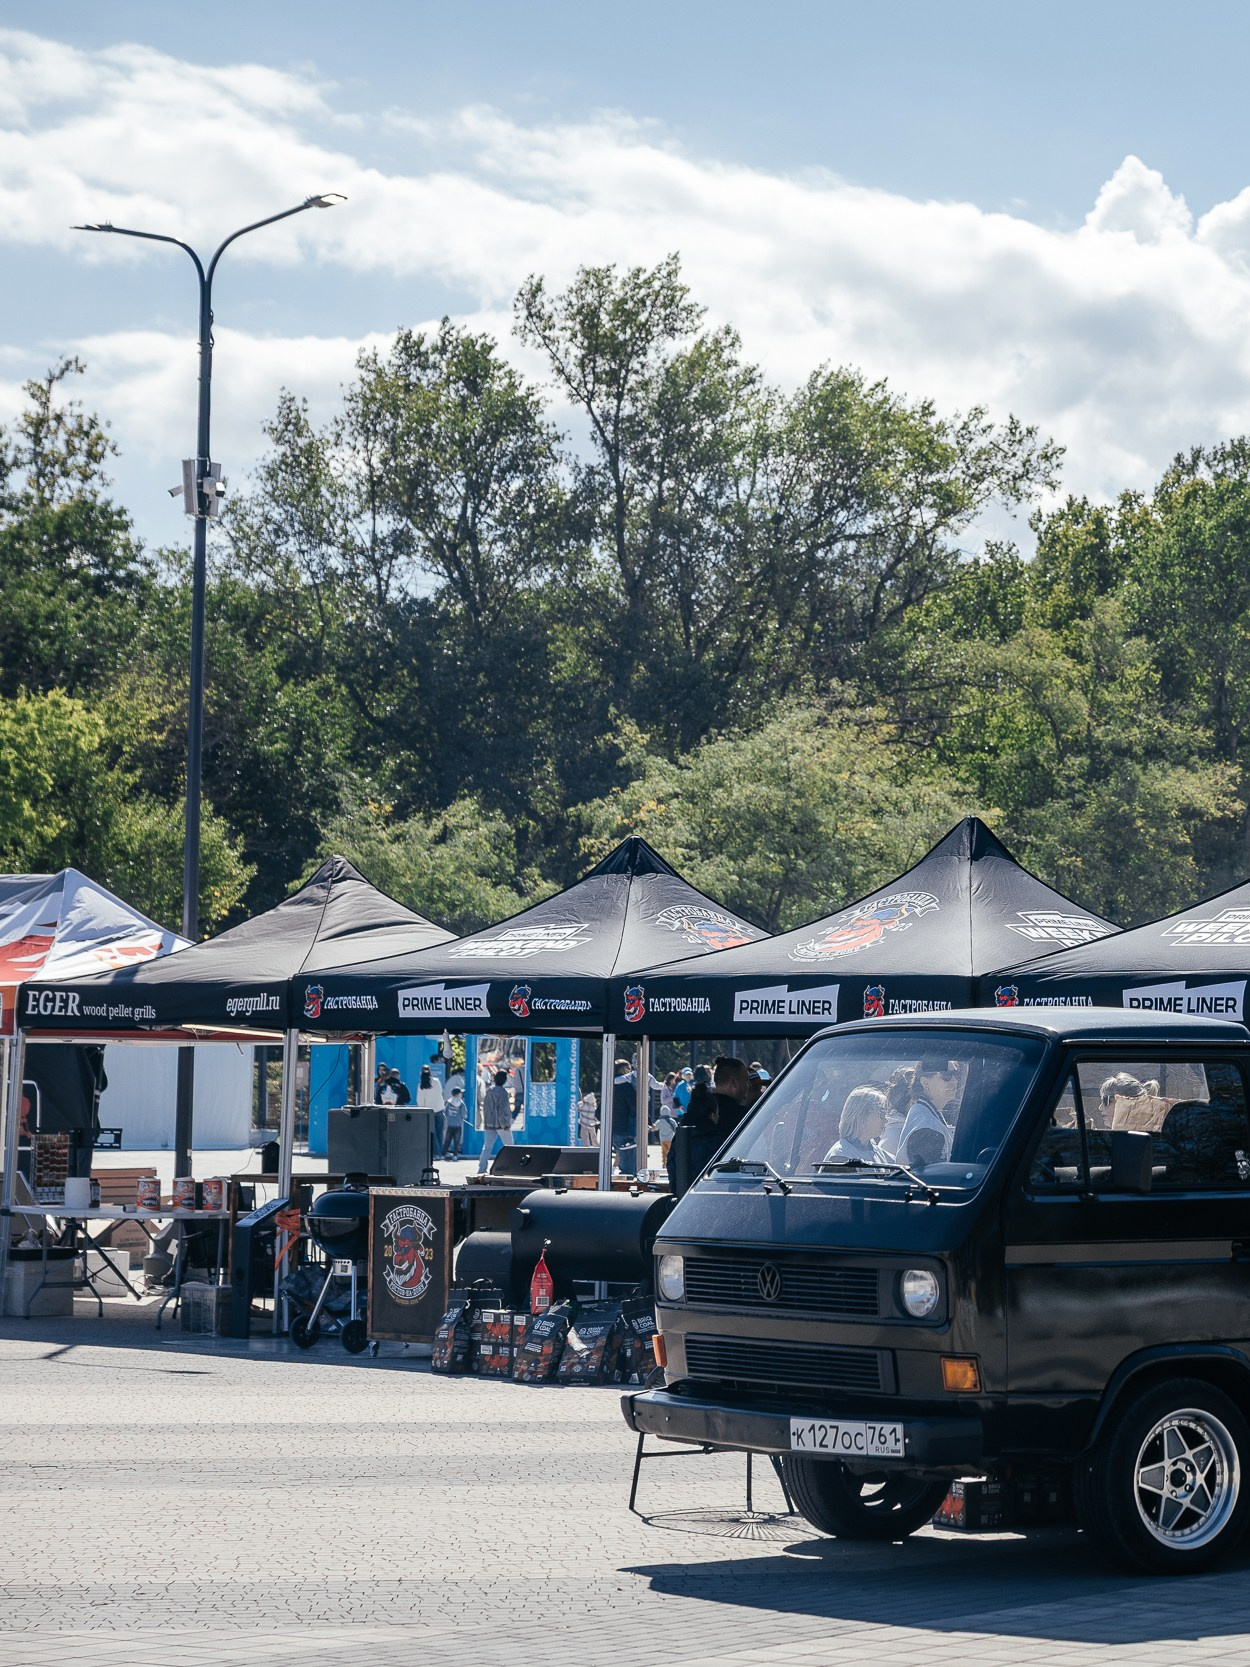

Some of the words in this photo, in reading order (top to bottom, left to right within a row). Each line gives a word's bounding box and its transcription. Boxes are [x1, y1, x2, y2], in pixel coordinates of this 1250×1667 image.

[26, 990, 80, 1016] EGER
[83, 1004, 107, 1017] wood
[108, 1004, 133, 1021] pellet
[134, 1005, 156, 1021] grills
[324, 995, 379, 1011] ГАСТРОБАНДА
[402, 996, 442, 1011] PRIME
[444, 996, 483, 1012] LINER
[649, 997, 711, 1012] ГАСТРОБАНДА
[739, 999, 785, 1015] PRIME
[788, 999, 832, 1016] LINER
[1129, 996, 1183, 1013] PRIME
[1187, 996, 1237, 1014] LINER
[389, 1207, 428, 1226] ГАСТРОБАНДА
[384, 1245, 392, 1257] 20
[425, 1248, 434, 1260] 23
[868, 1426, 898, 1446] 761
[875, 1446, 890, 1454] RUS
